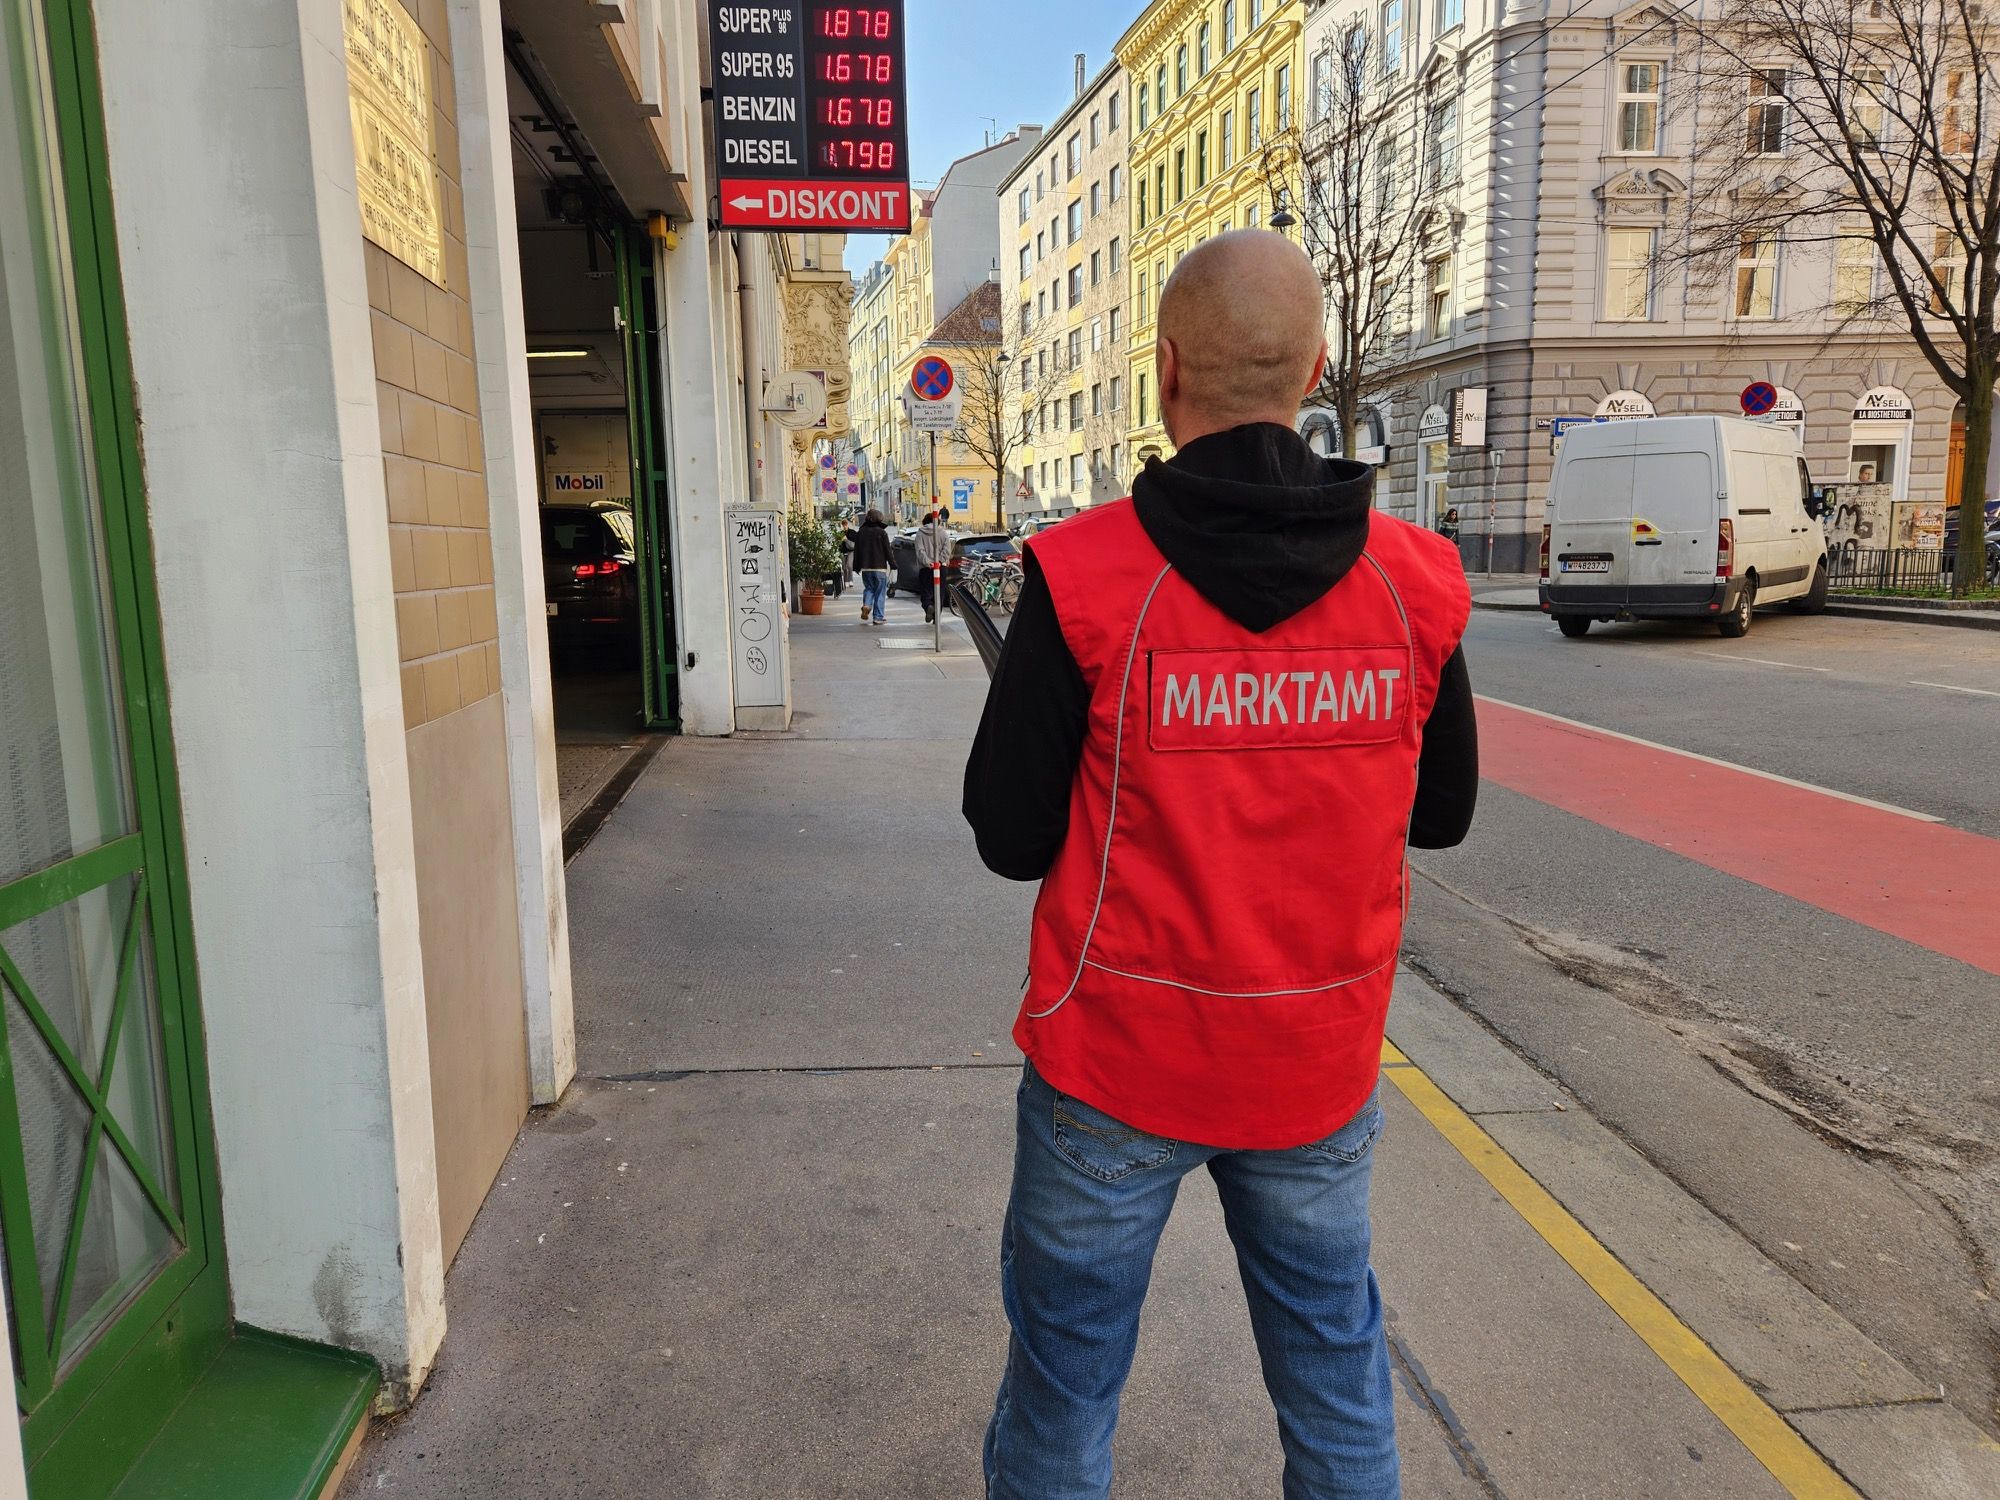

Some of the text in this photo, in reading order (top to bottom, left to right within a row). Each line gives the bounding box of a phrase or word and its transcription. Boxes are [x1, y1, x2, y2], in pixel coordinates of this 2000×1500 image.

[719, 7, 792, 34] SUPER PLUS 98
[721, 52, 794, 78] SUPER 95
[723, 96, 796, 122] BENZIN
[725, 138, 798, 164] DIESEL
[767, 189, 900, 220] DISKONT
[555, 475, 604, 490] Mobil
[1162, 669, 1401, 726] MARKTAMT
